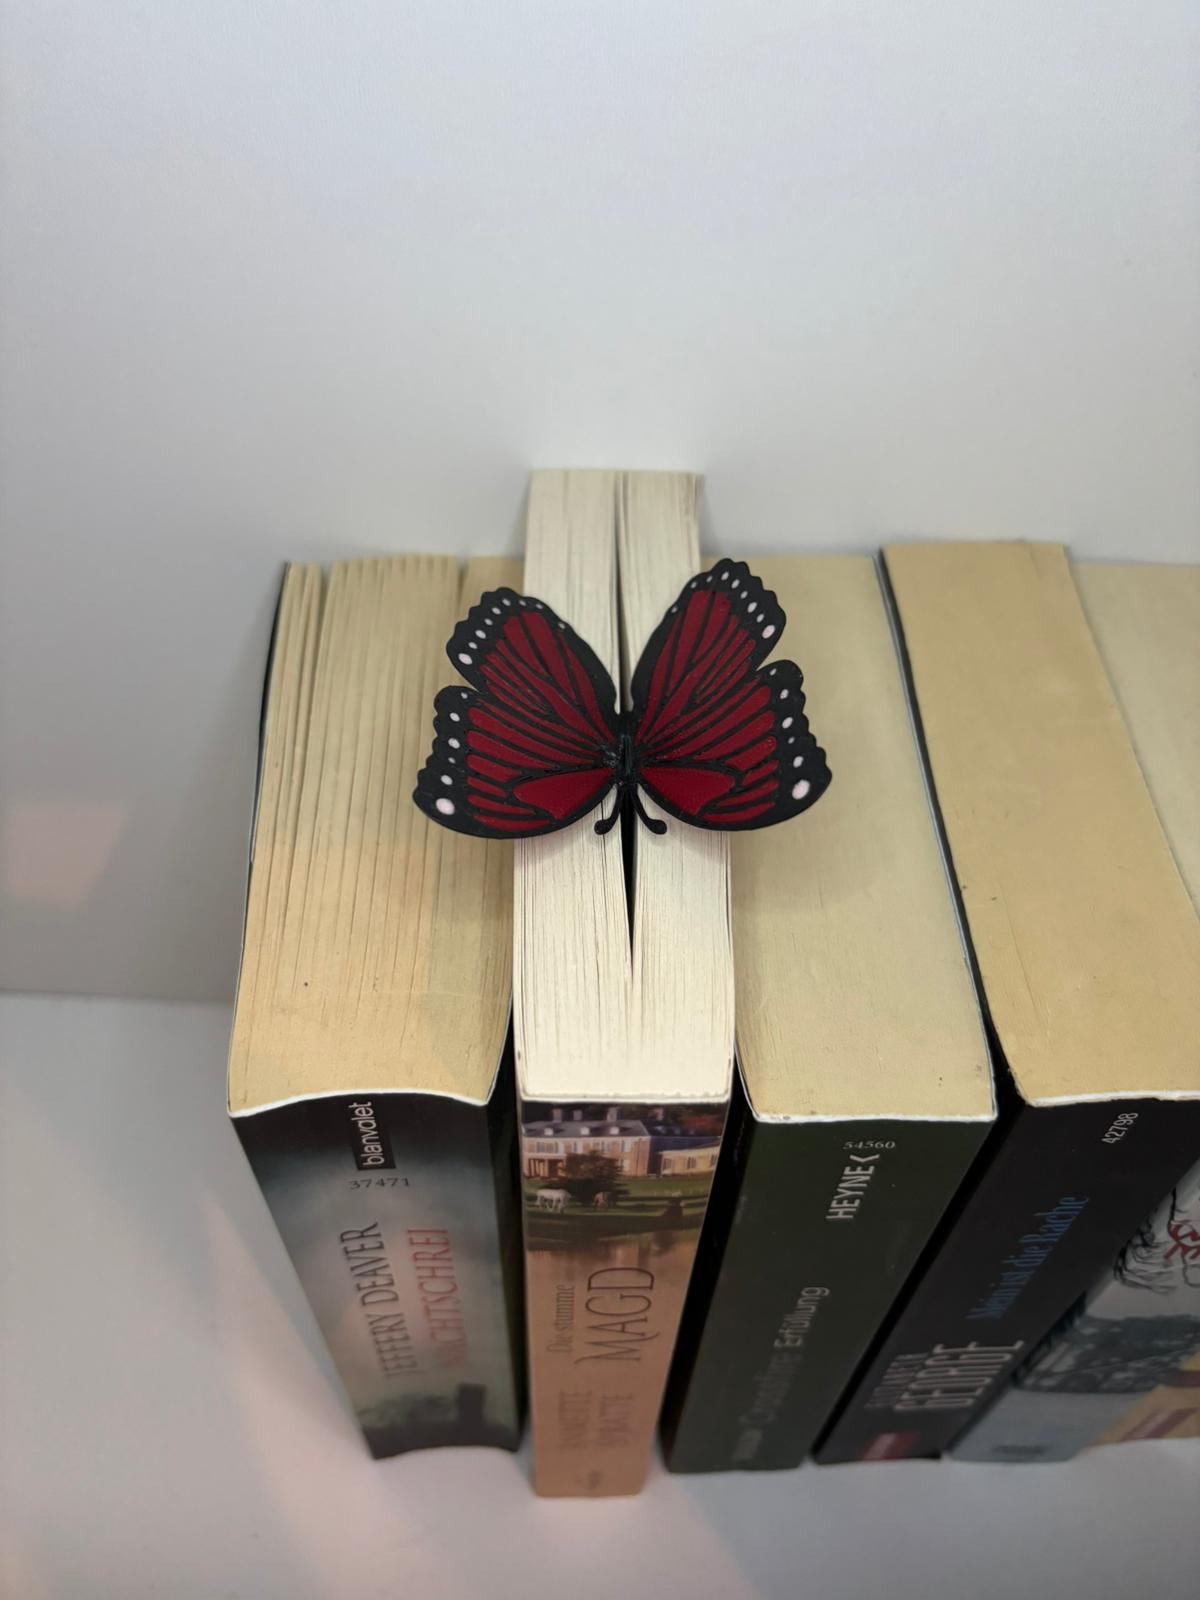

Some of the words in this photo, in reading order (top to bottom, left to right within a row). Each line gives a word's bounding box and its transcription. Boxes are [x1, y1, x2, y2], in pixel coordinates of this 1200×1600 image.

[348, 1101, 385, 1166] blanvalet
[843, 1141, 896, 1150] 54560
[1101, 1112, 1139, 1144] 42798
[350, 1177, 410, 1191] 37471
[1019, 1197, 1090, 1244] Rache
[340, 1221, 399, 1306] DEAVER
[1002, 1245, 1054, 1268] die
[406, 1228, 467, 1367] NACHTSCHREI
[552, 1284, 575, 1332] stumme
[574, 1267, 661, 1365] MAGD
[773, 1286, 831, 1348] Erfüllung
[366, 1312, 427, 1378] JEFFERY
[546, 1335, 573, 1353] Die
[893, 1339, 1024, 1413] GEORGE
